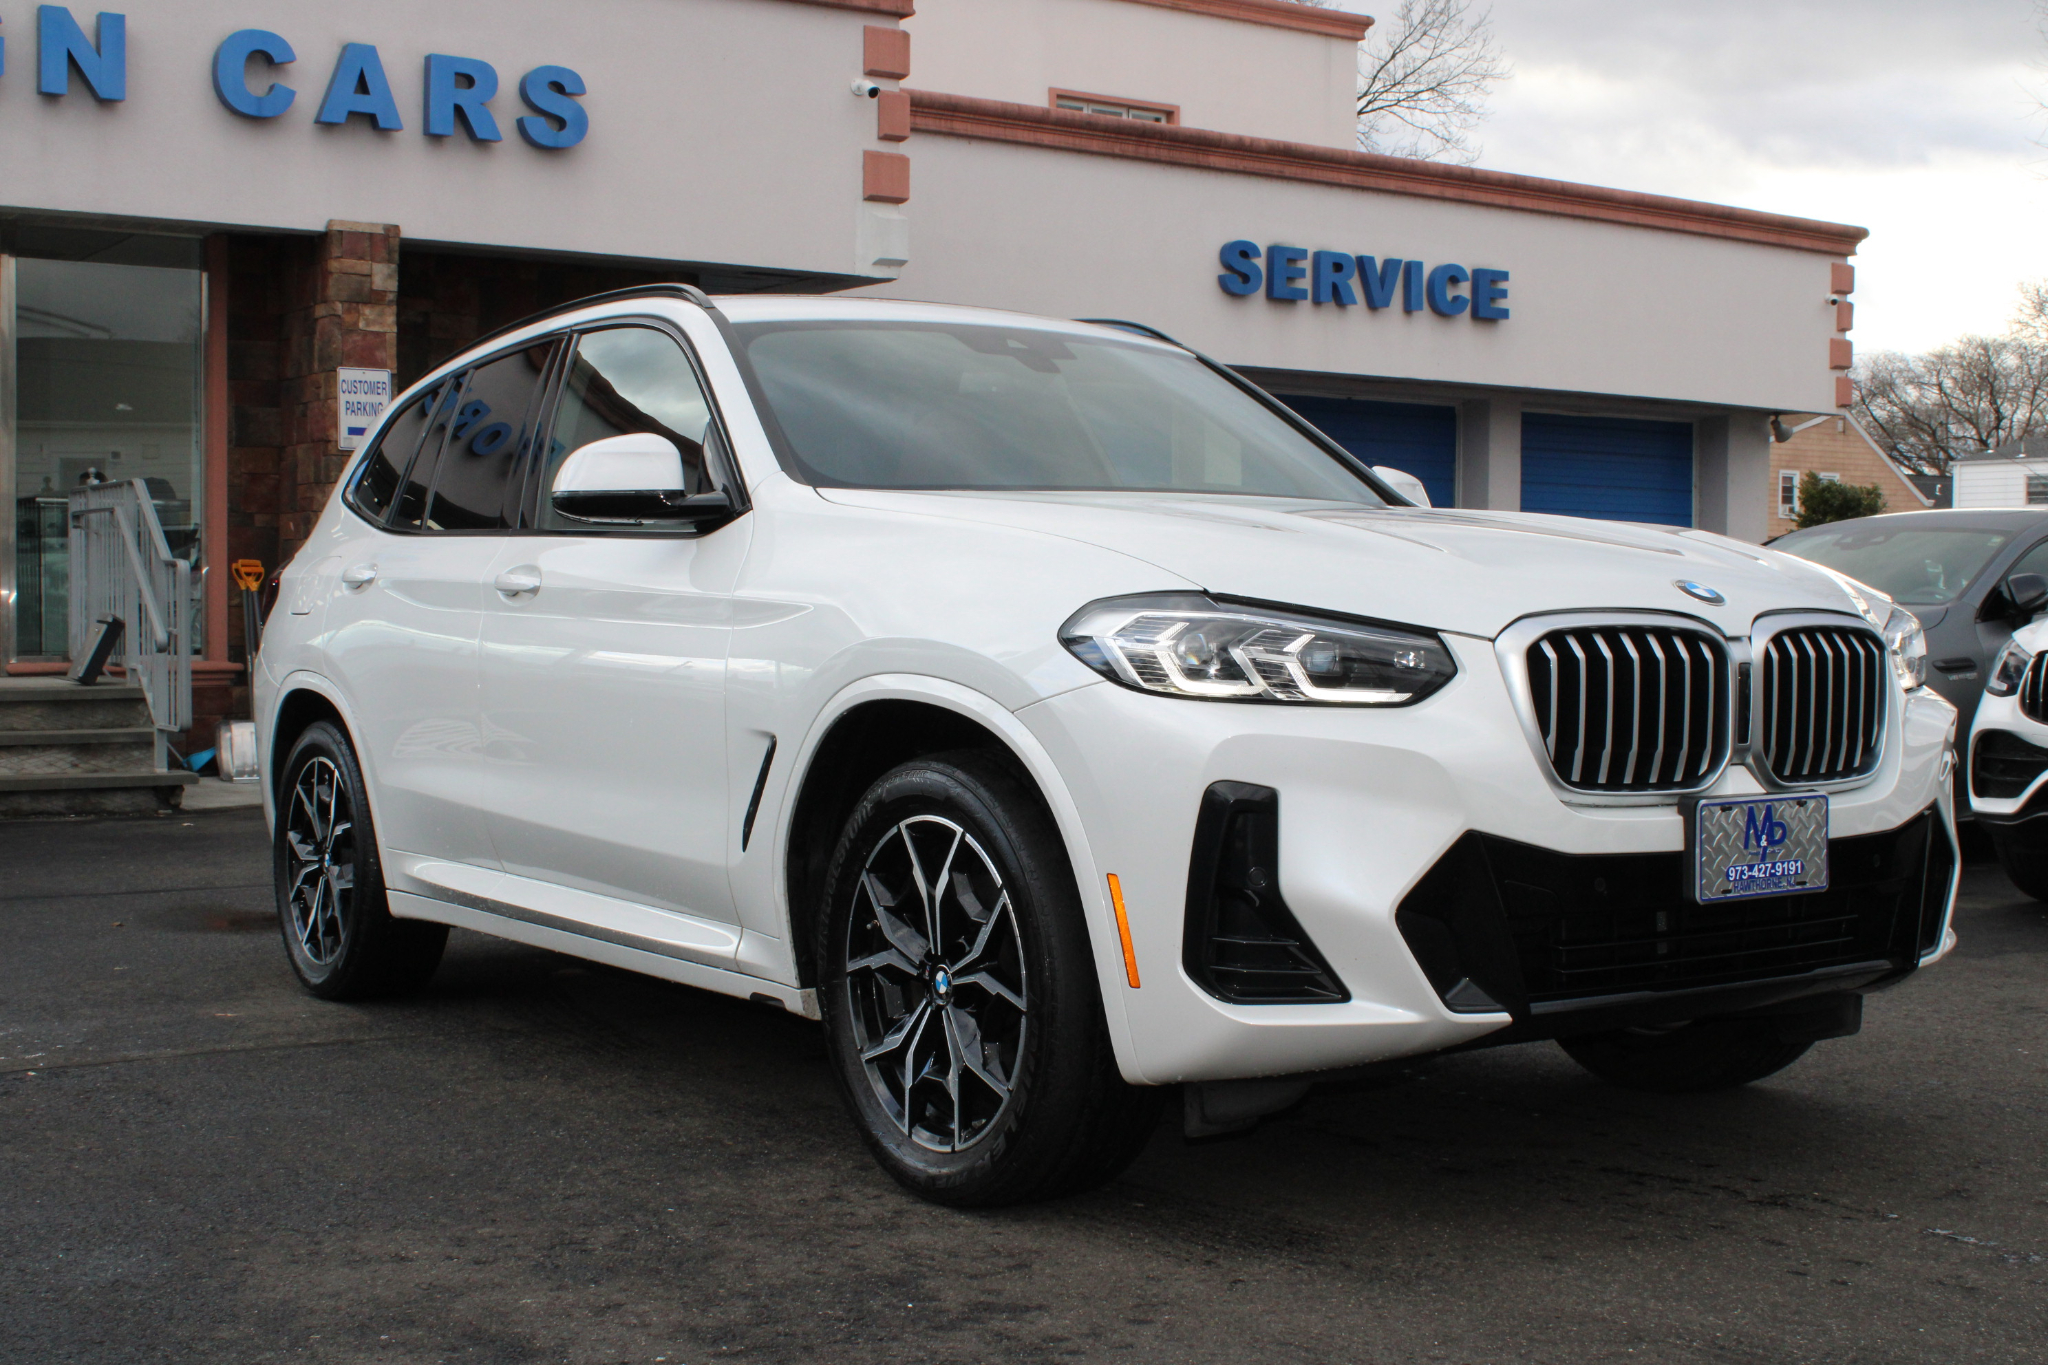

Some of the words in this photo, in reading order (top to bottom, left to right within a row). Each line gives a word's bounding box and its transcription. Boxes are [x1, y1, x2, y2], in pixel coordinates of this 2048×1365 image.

[0, 5, 126, 102] N
[212, 29, 589, 149] CARS
[1218, 239, 1510, 320] SERVICE
[340, 379, 388, 396] CUSTOMER
[345, 401, 384, 417] PARKING
[1728, 860, 1802, 881] 973-427-9191
